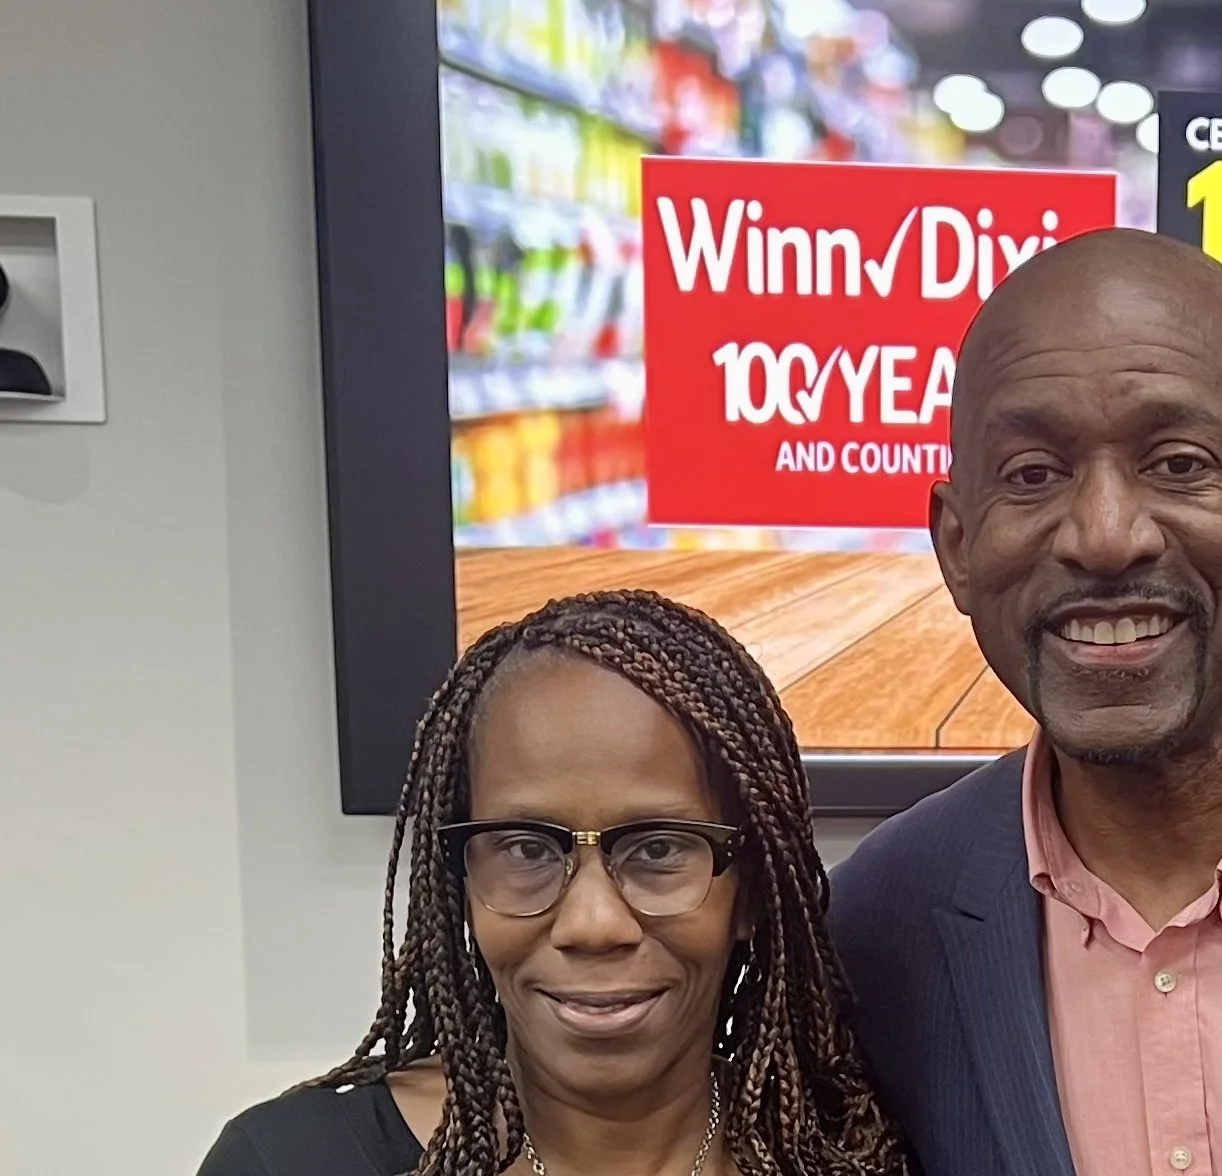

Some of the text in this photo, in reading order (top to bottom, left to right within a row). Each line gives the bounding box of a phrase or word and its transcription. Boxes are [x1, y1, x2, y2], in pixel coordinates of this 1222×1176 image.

[838, 345, 957, 424] YEA
[775, 441, 953, 474] AND COUNTI
